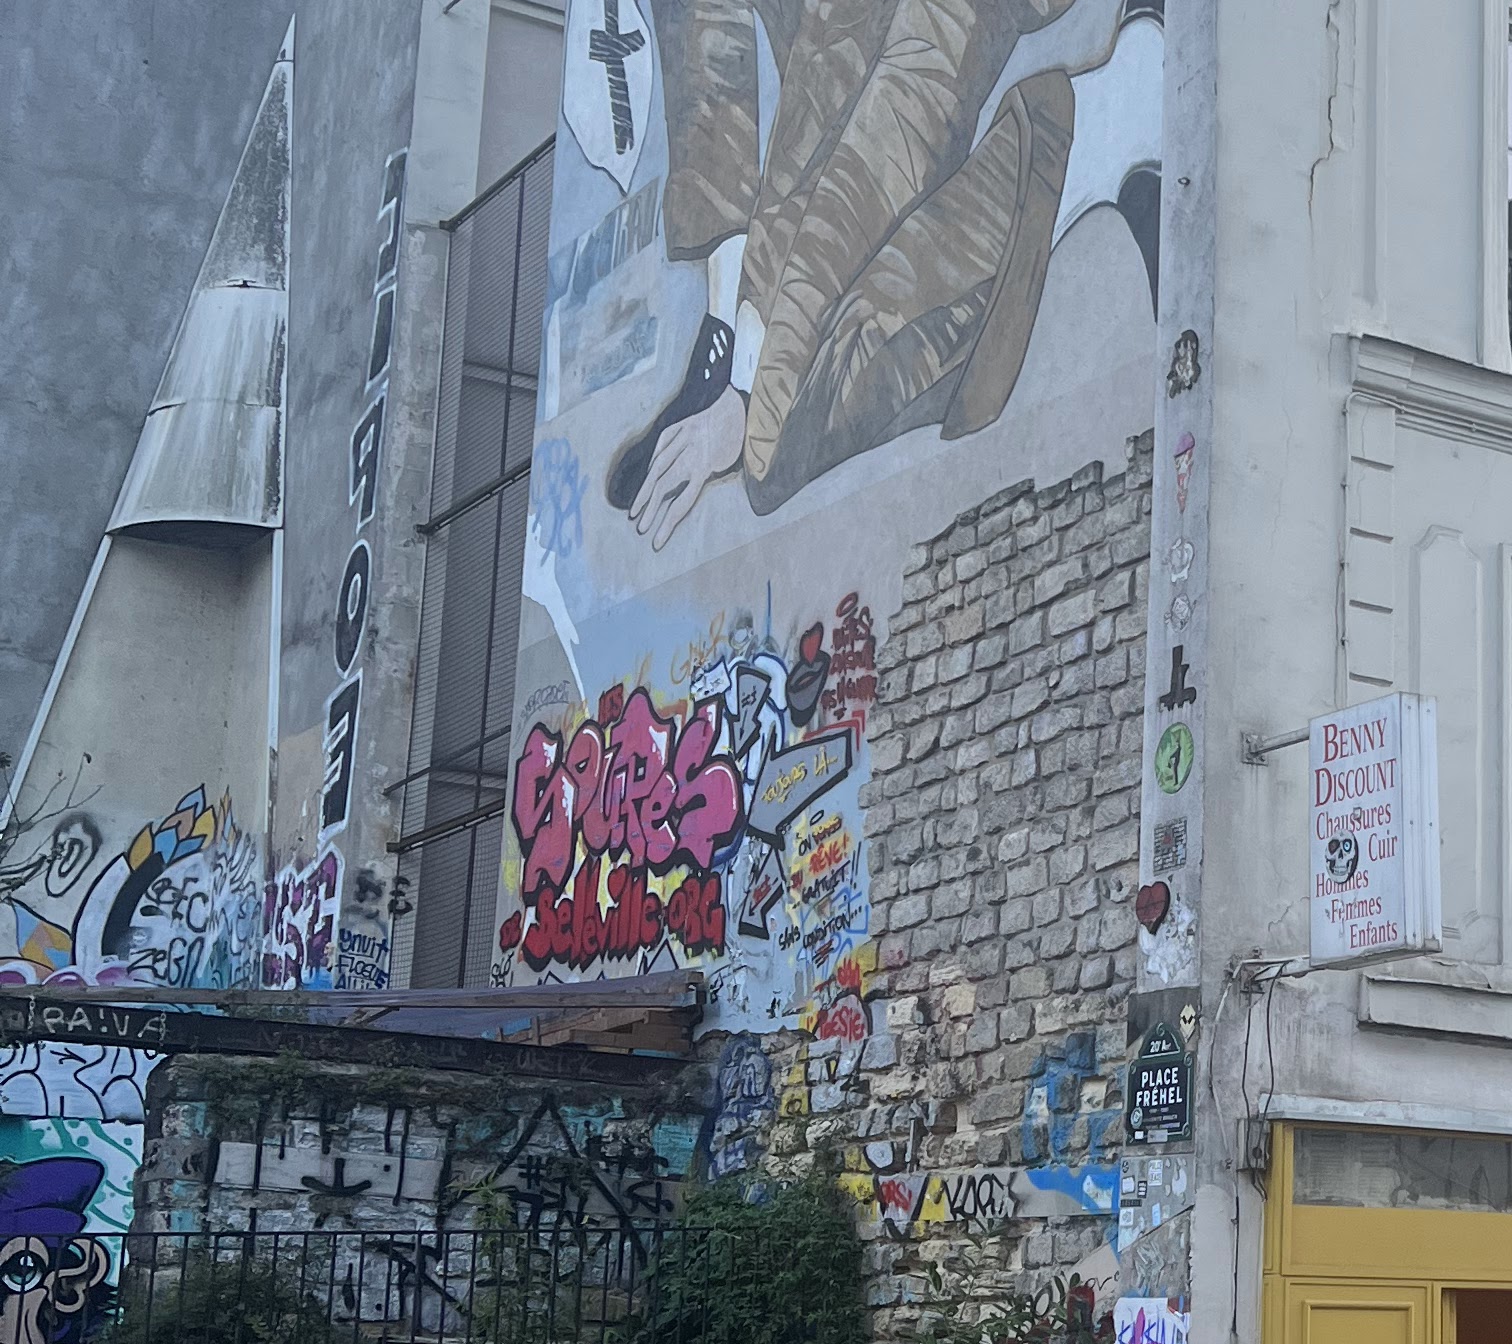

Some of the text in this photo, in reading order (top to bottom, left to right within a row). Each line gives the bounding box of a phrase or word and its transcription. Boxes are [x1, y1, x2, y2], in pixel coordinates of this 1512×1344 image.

[1322, 717, 1388, 764] BENNY
[1314, 757, 1397, 807] DISCOUNT
[1367, 830, 1398, 862] Cuir
[1330, 896, 1382, 924] Femmes
[1349, 919, 1398, 949] Enfants
[1141, 1067, 1179, 1089] PLACE
[1136, 1085, 1183, 1107] FRÉHEL
